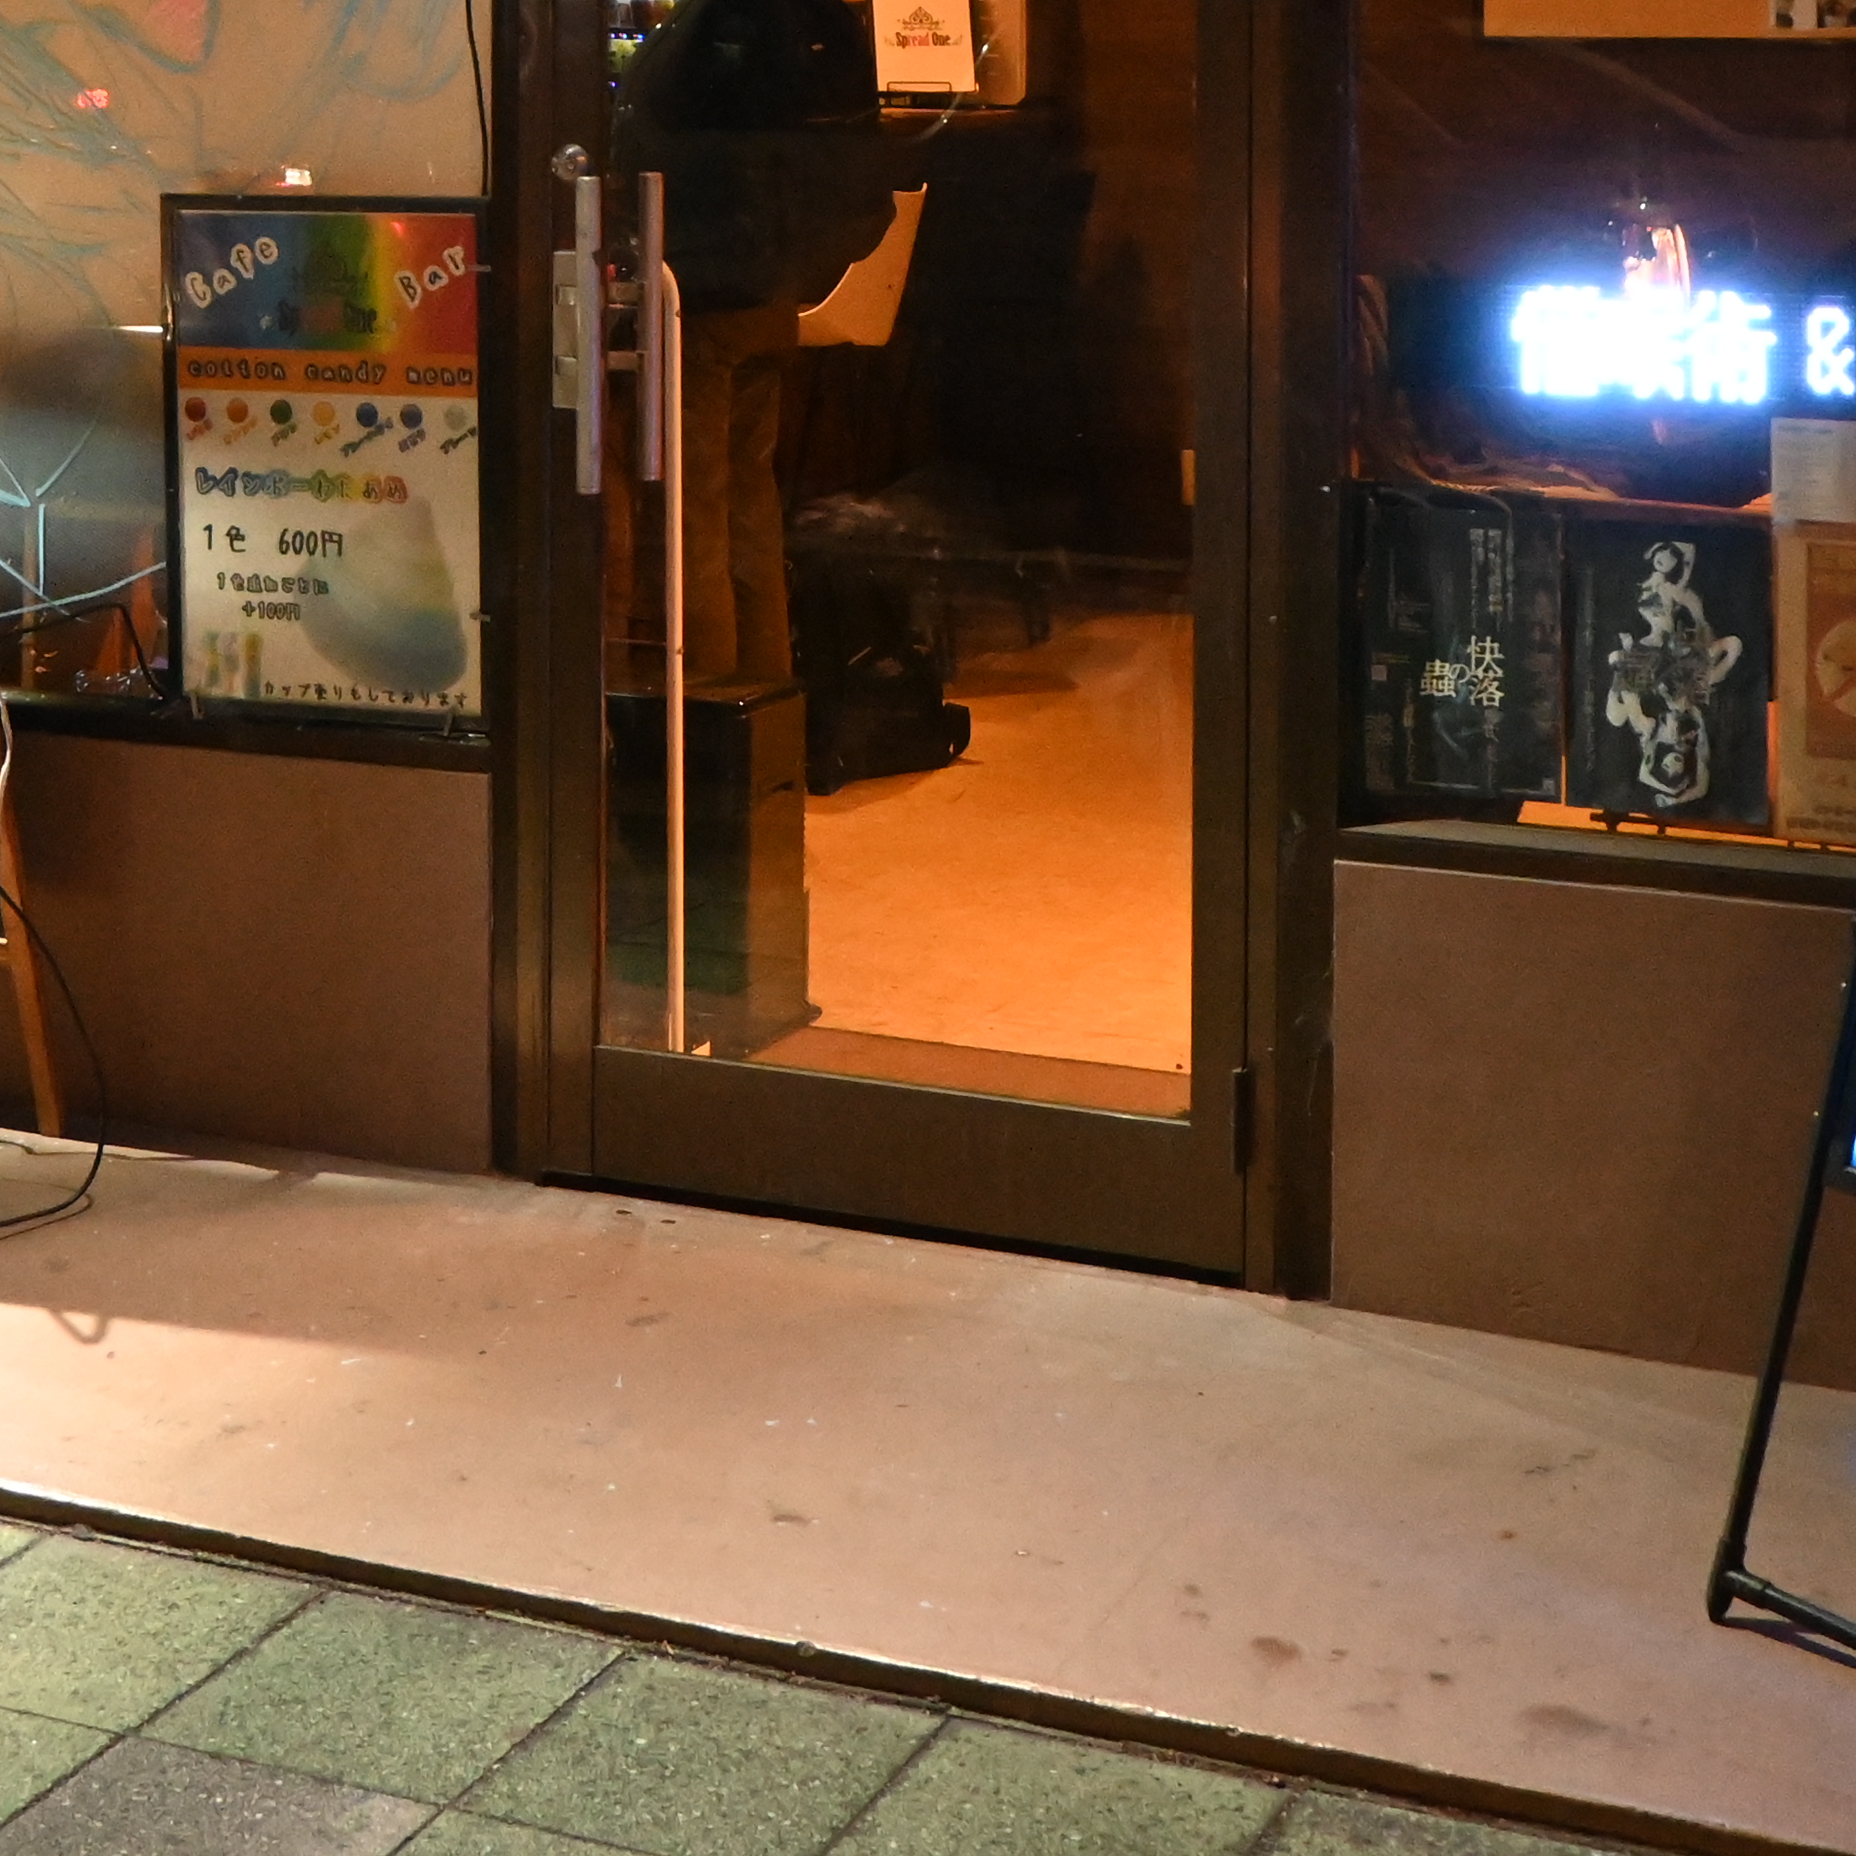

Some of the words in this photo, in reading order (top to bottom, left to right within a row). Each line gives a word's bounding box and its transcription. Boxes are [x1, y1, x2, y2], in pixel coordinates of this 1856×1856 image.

[185, 236, 279, 308] Cafe
[395, 245, 464, 308] Bar
[188, 357, 286, 380] cotton
[305, 359, 387, 385] candy
[406, 366, 473, 387] menu
[278, 528, 343, 558] 600円
